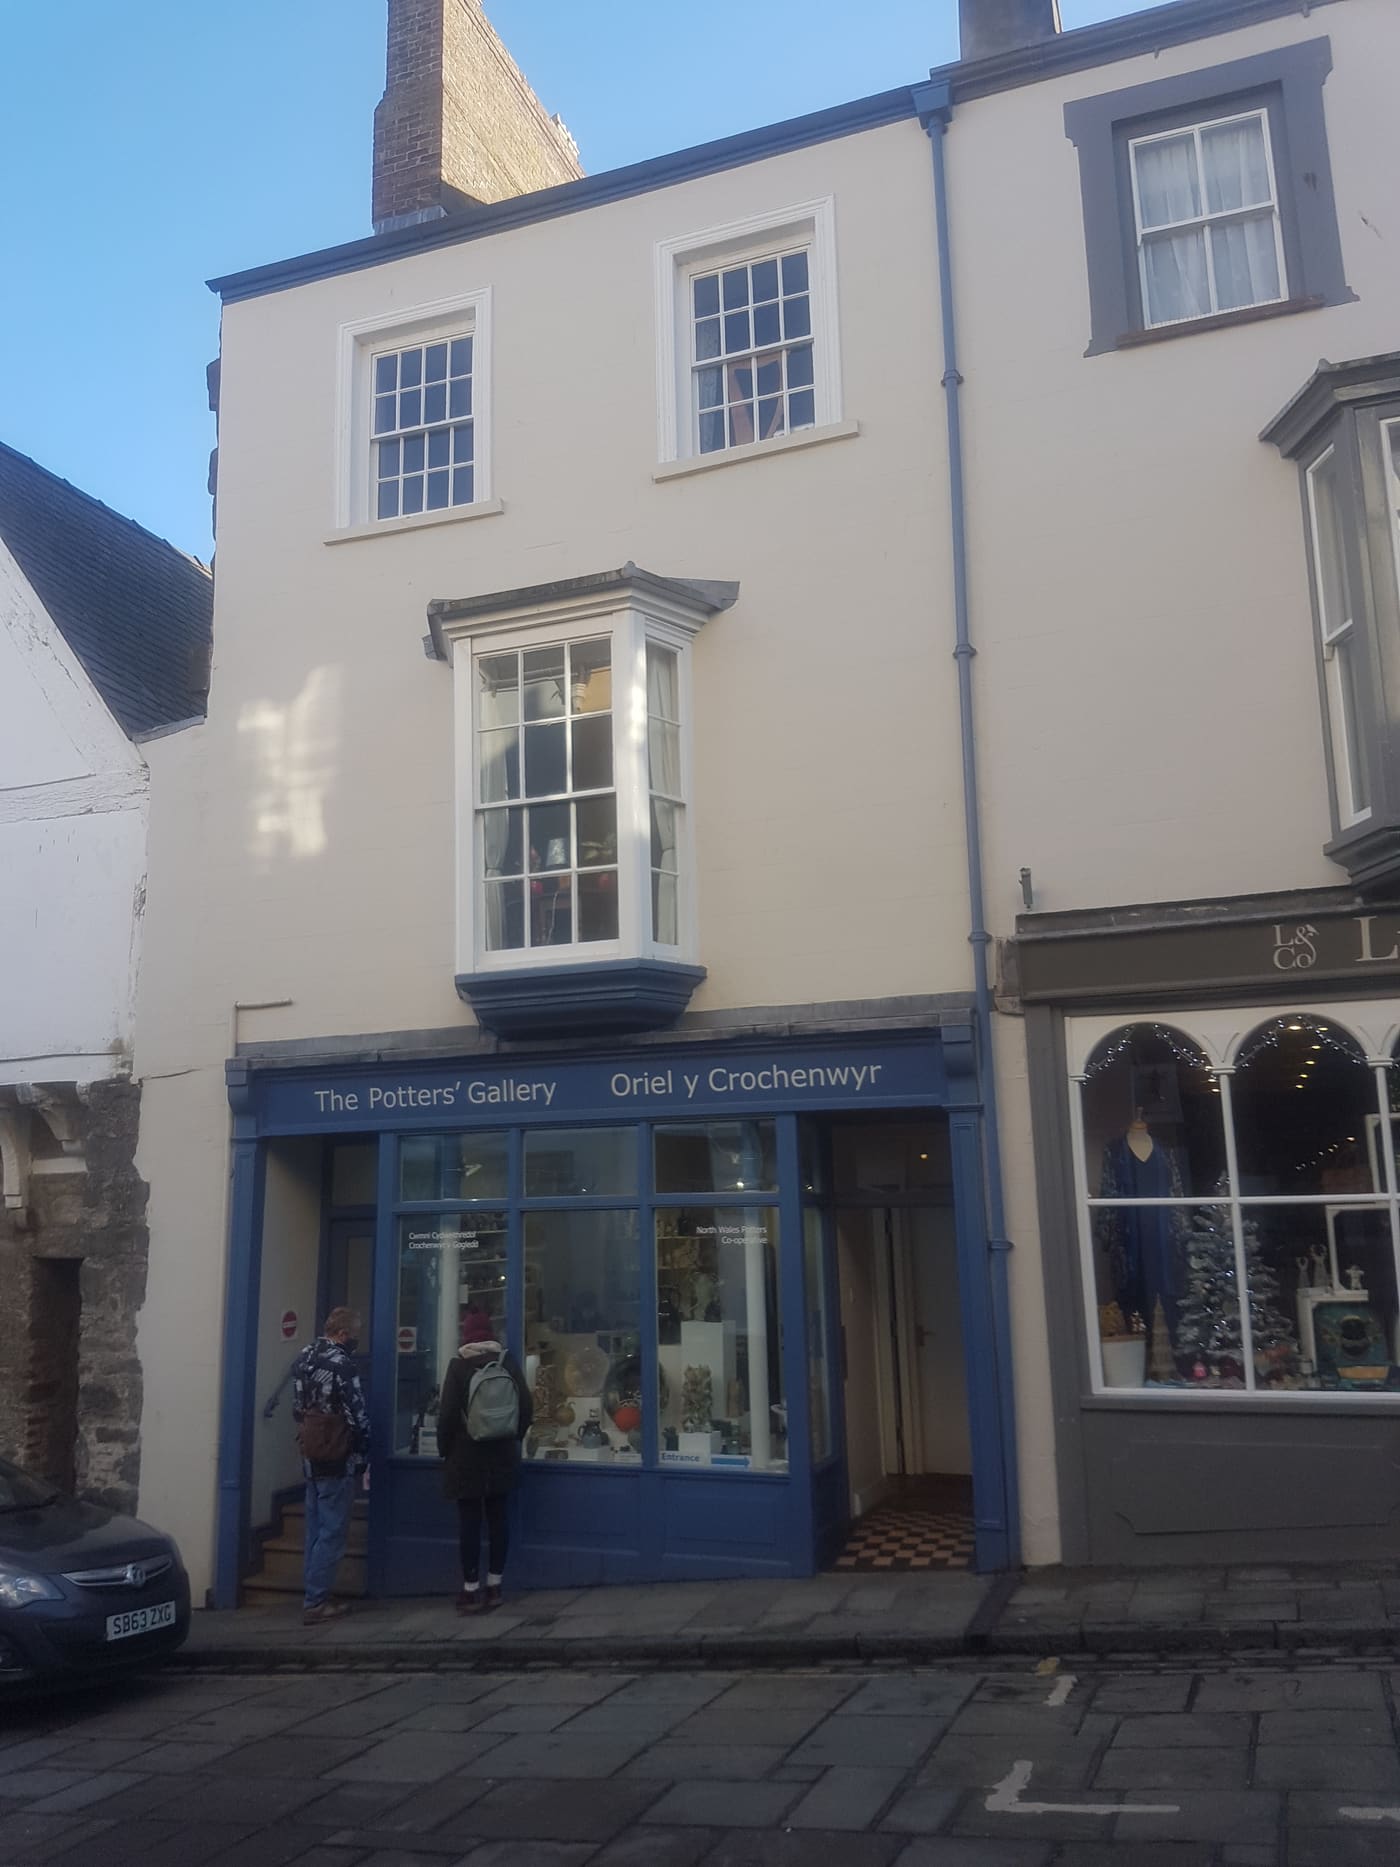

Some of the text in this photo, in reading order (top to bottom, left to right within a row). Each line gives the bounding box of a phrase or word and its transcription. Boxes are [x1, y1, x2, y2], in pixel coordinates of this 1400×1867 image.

[1352, 915, 1400, 962] L
[1273, 946, 1312, 970] Co
[610, 1064, 882, 1098] Oriel y Crochenwyr
[314, 1089, 359, 1112] The
[467, 1079, 556, 1105] Gallery
[696, 1226, 717, 1234] North
[718, 1225, 740, 1234] Wales
[721, 1236, 768, 1245] Co-opee
[661, 1452, 700, 1462] Entrance
[113, 1604, 171, 1635] SB63 ZXG
